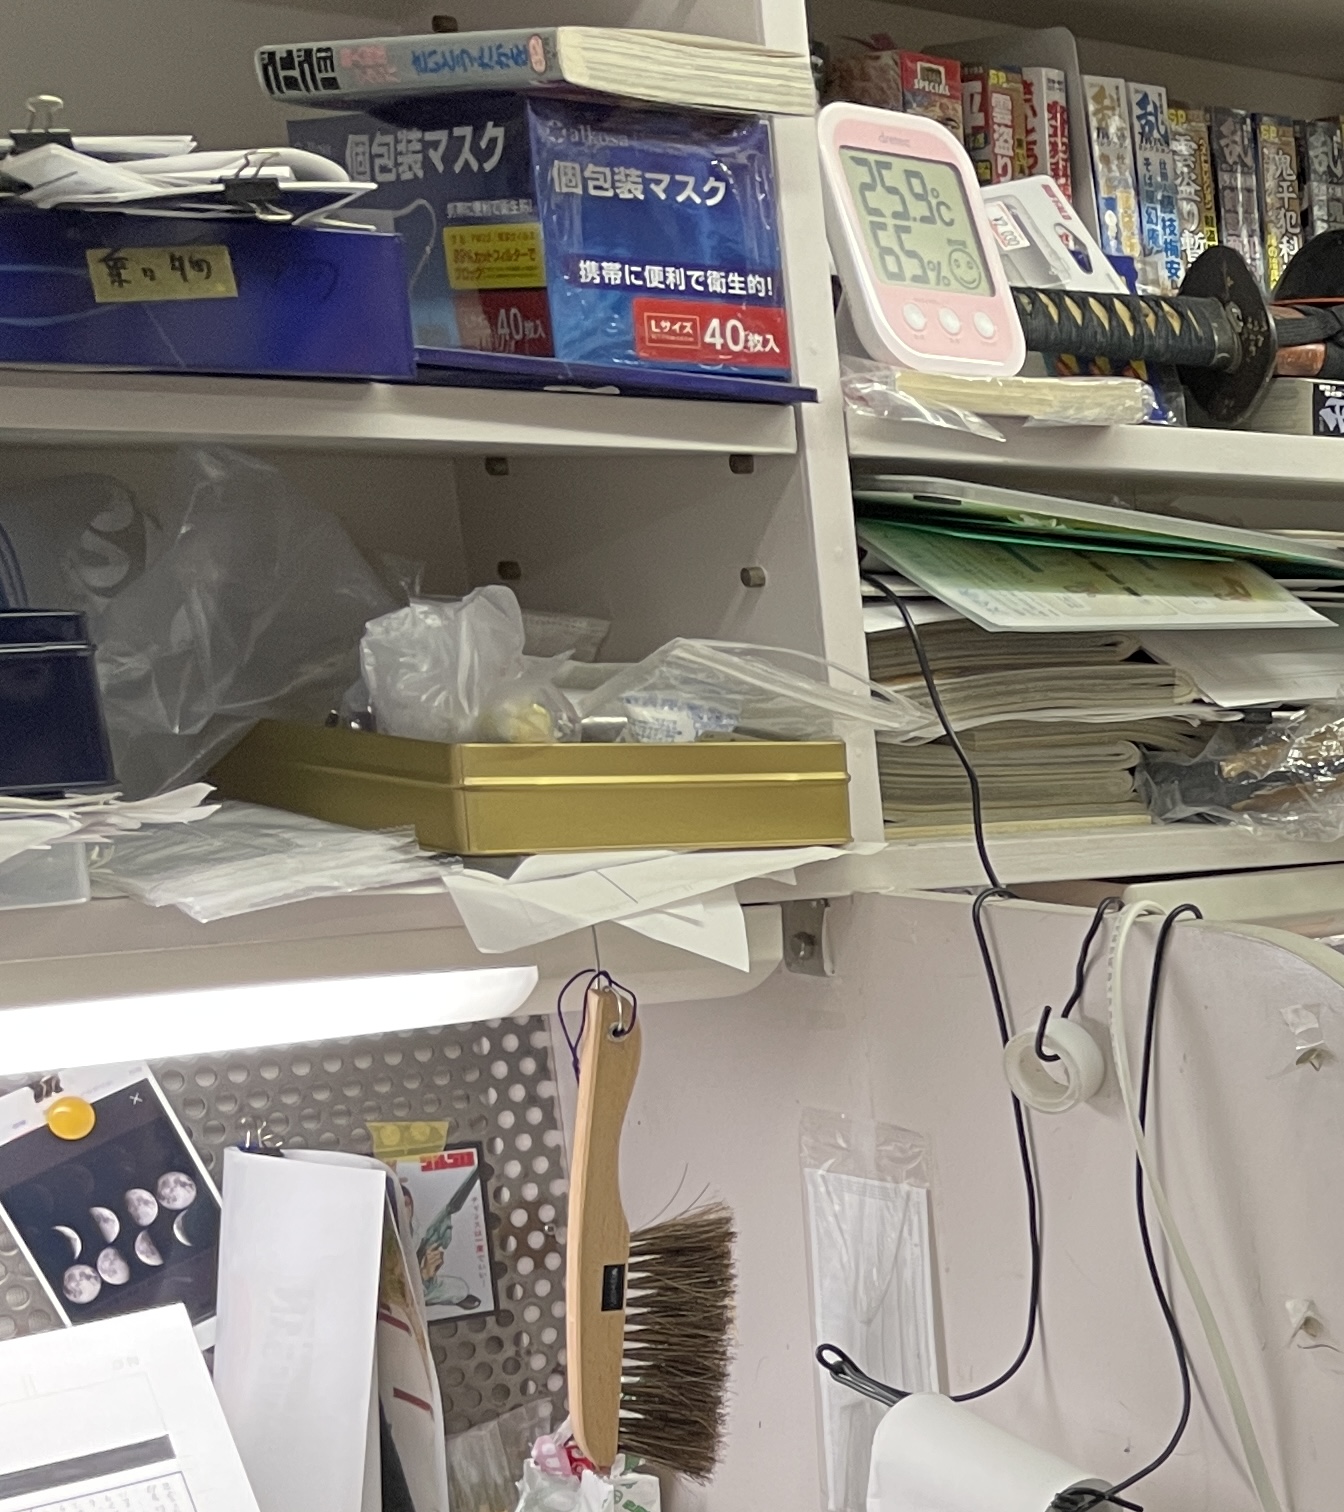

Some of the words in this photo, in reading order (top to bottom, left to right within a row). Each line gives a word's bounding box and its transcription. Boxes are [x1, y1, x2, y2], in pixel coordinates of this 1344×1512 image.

[913, 78, 950, 96] SPECIAL
[345, 121, 505, 183] 個包装マスク
[552, 160, 727, 208] 個包装マスク
[578, 260, 774, 298] 携帯に便利で衛生的!
[650, 319, 694, 335] Lサイズ
[703, 318, 781, 354] 40枚入
